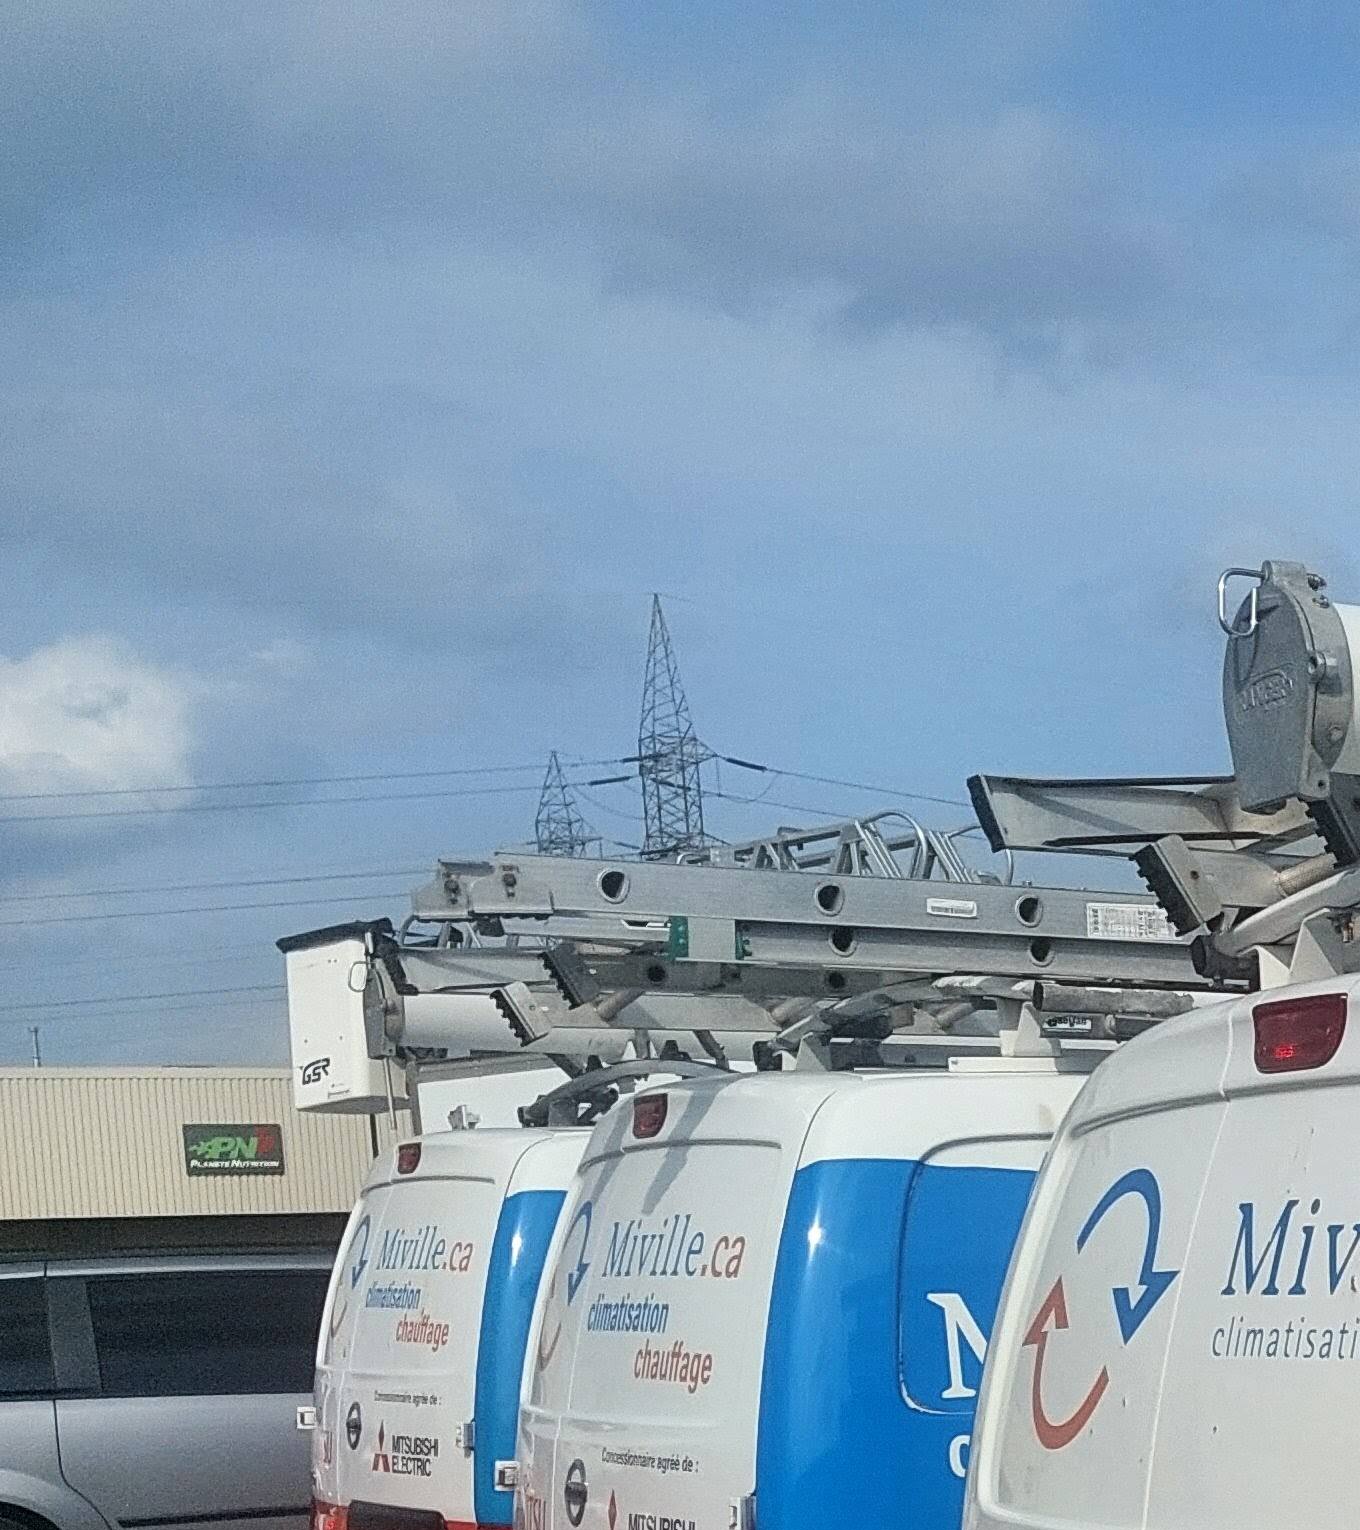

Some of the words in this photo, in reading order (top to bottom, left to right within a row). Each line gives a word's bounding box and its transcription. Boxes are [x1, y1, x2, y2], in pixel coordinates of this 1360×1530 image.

[376, 1226, 474, 1272] Miville.ca
[602, 1214, 746, 1279] Miville.ca
[396, 1310, 450, 1352] chauffage
[587, 1293, 670, 1333] climatisation
[633, 1338, 713, 1394] chauffage
